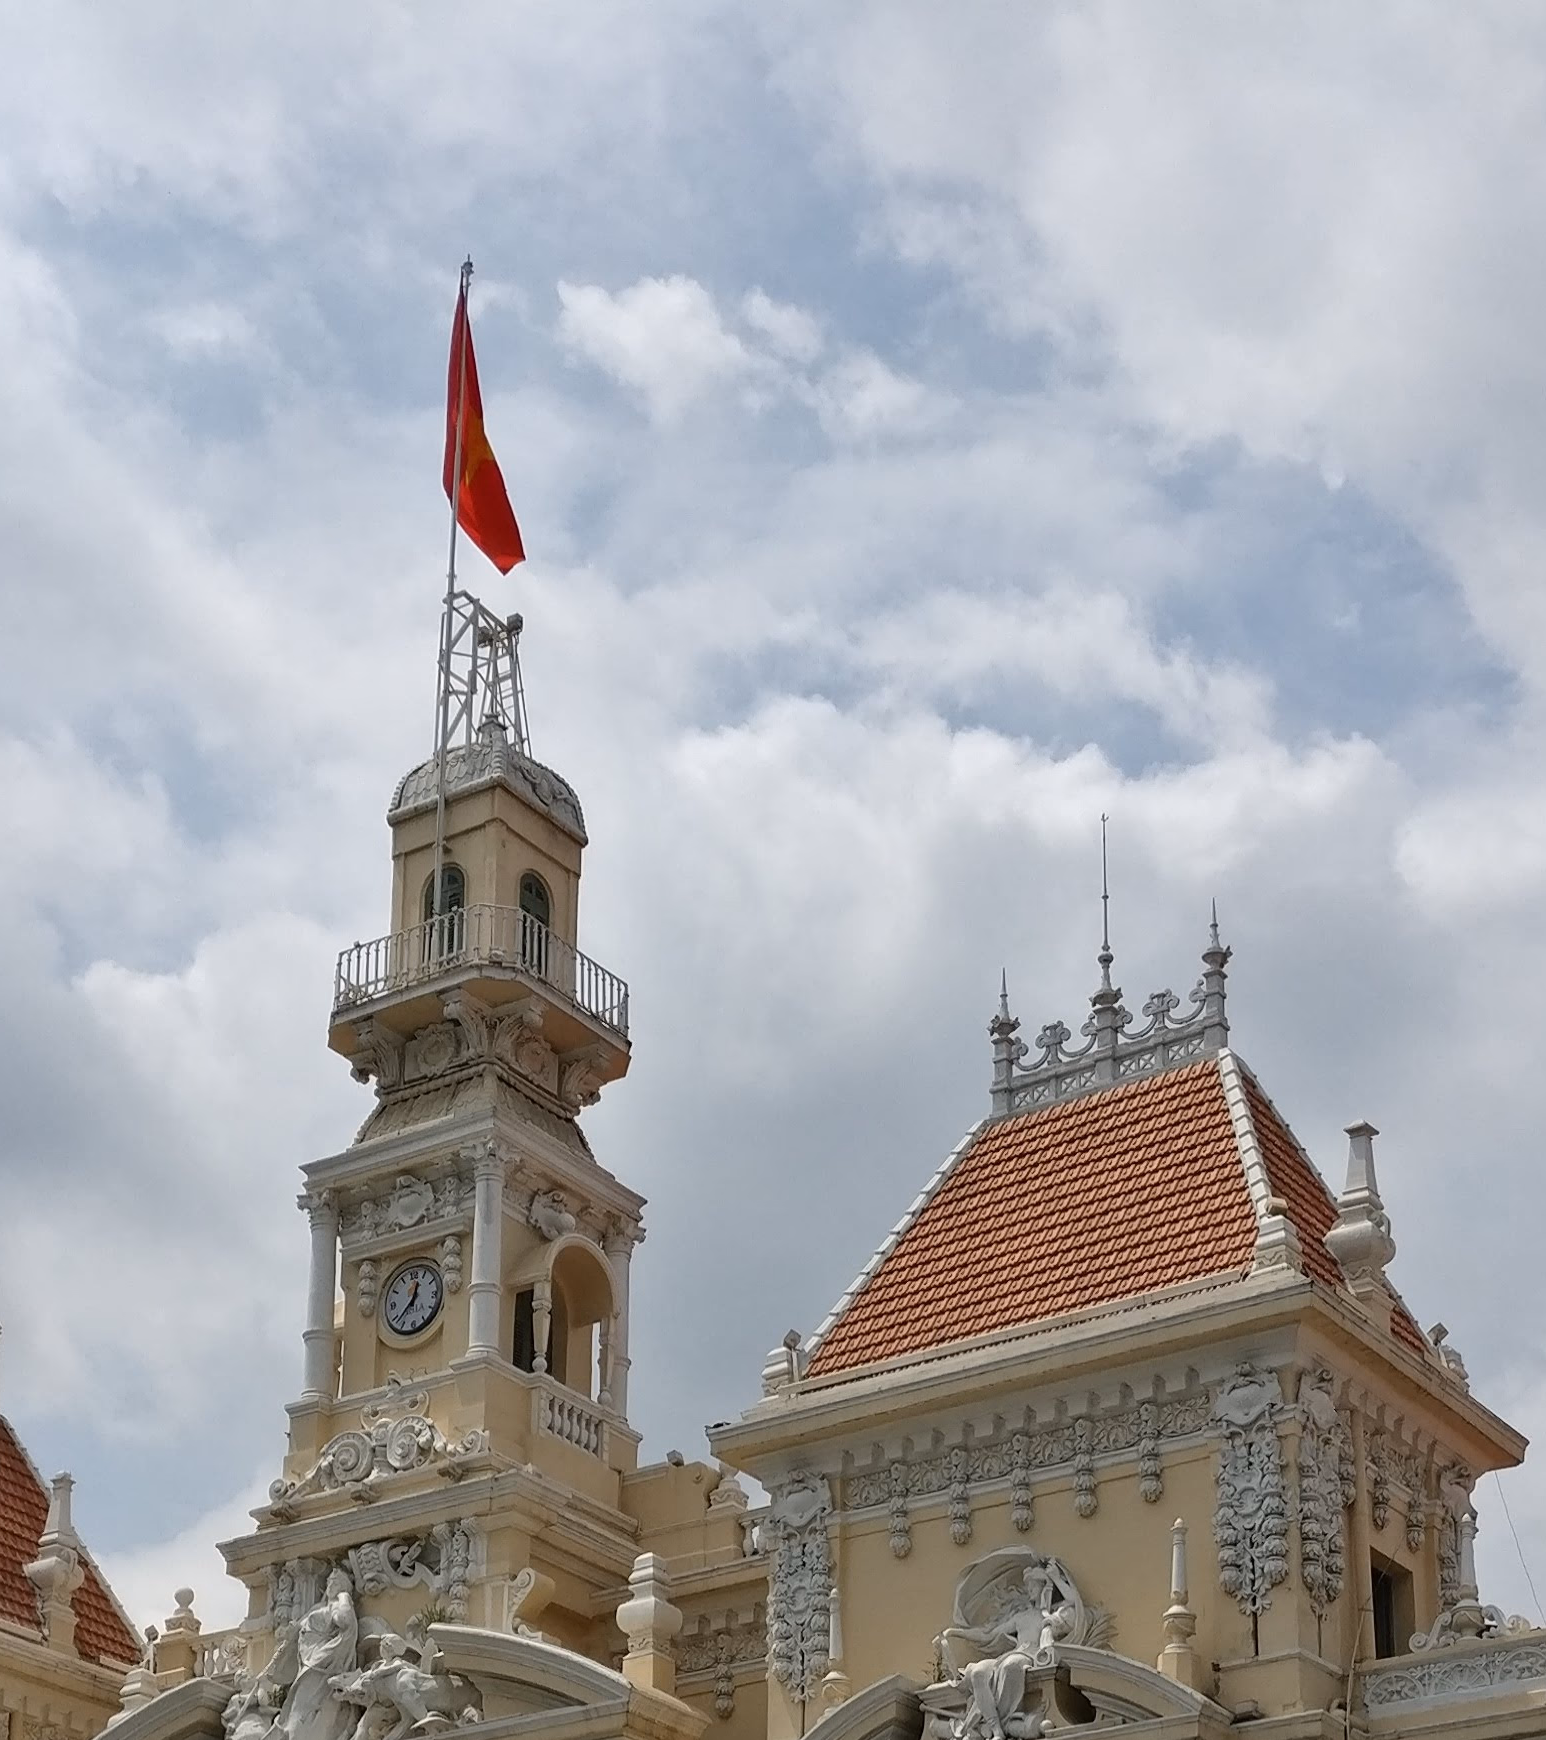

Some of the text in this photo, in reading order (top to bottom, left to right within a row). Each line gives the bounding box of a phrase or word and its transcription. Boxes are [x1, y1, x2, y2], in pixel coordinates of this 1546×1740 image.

[410, 1271, 419, 1280] 12
[431, 1290, 438, 1299] 3
[390, 1301, 397, 1311] 9
[410, 1320, 417, 1329] 6
